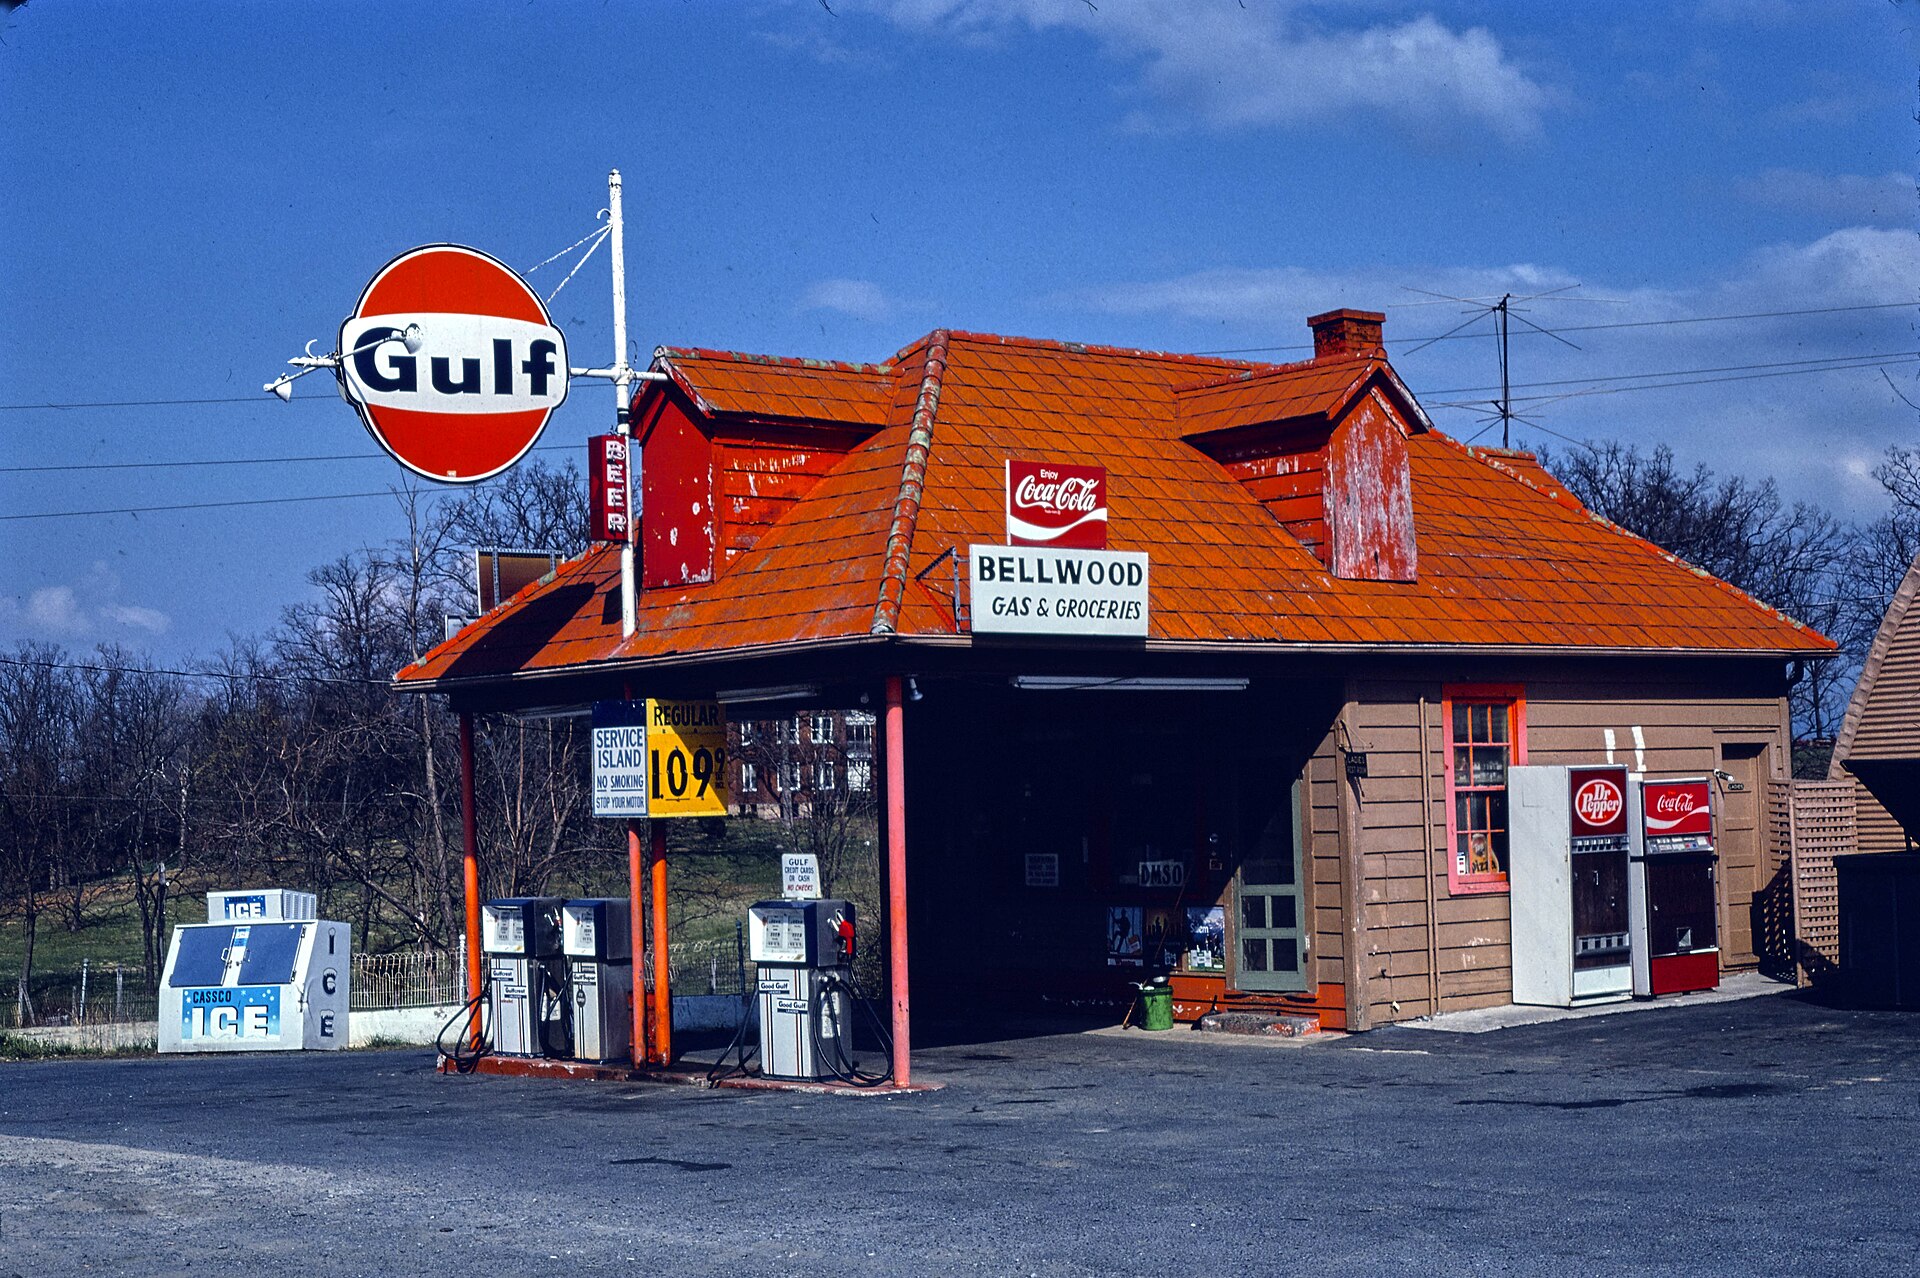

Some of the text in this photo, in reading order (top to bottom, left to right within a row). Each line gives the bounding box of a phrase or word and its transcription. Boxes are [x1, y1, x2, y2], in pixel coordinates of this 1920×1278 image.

[354, 326, 557, 396] Gulf
[1040, 468, 1058, 480] Enjoy
[605, 440, 627, 533] BEER
[1015, 475, 1099, 512] Coca-Cola
[978, 555, 1143, 587] BELLWOOD
[992, 597, 1142, 620] GAS & GROCERIES
[654, 704, 719, 727] REGULAR
[596, 729, 644, 748] SERVICE
[598, 750, 642, 769] ISLAND
[597, 775, 643, 789] NO SMOKING
[1593, 783, 1611, 801] Dr
[596, 797, 644, 809] STOP YOUR MOTOR
[1581, 792, 1619, 820] Pepper
[1657, 792, 1694, 813] Coca-Cola
[788, 858, 809, 866] GULF
[800, 866, 814, 874] CARDS
[1141, 862, 1183, 884] DMSO
[795, 884, 813, 892] CHECKS
[228, 902, 262, 919] ICE
[320, 927, 338, 1038] ICE
[193, 990, 232, 1004] CASSCO
[191, 1004, 269, 1037] ICE
